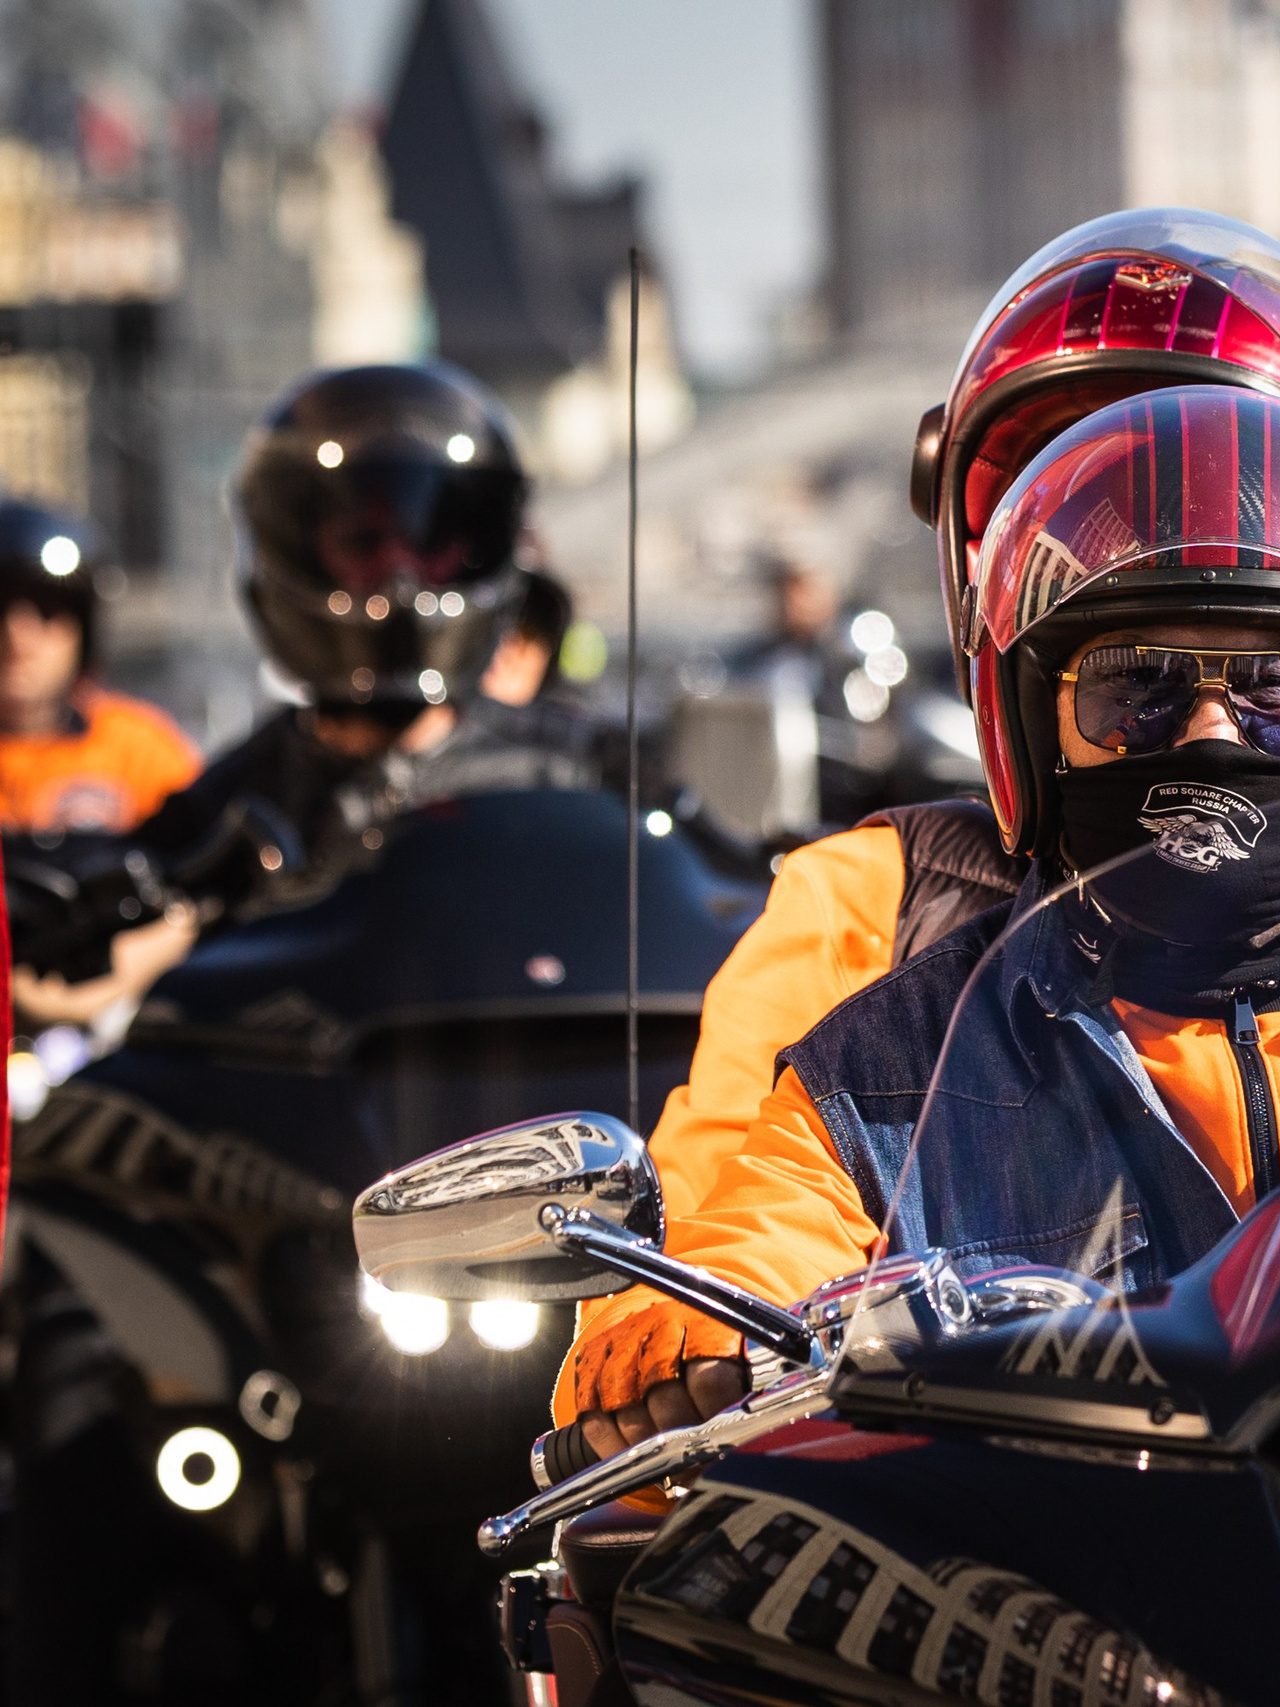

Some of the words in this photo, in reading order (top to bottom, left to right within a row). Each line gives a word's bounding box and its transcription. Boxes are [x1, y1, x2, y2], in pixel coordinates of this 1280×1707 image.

[1159, 787, 1179, 796] RED
[1180, 787, 1222, 801] SQUARE
[1222, 796, 1260, 825] CHAPTER
[1191, 797, 1230, 814] RUSSIA
